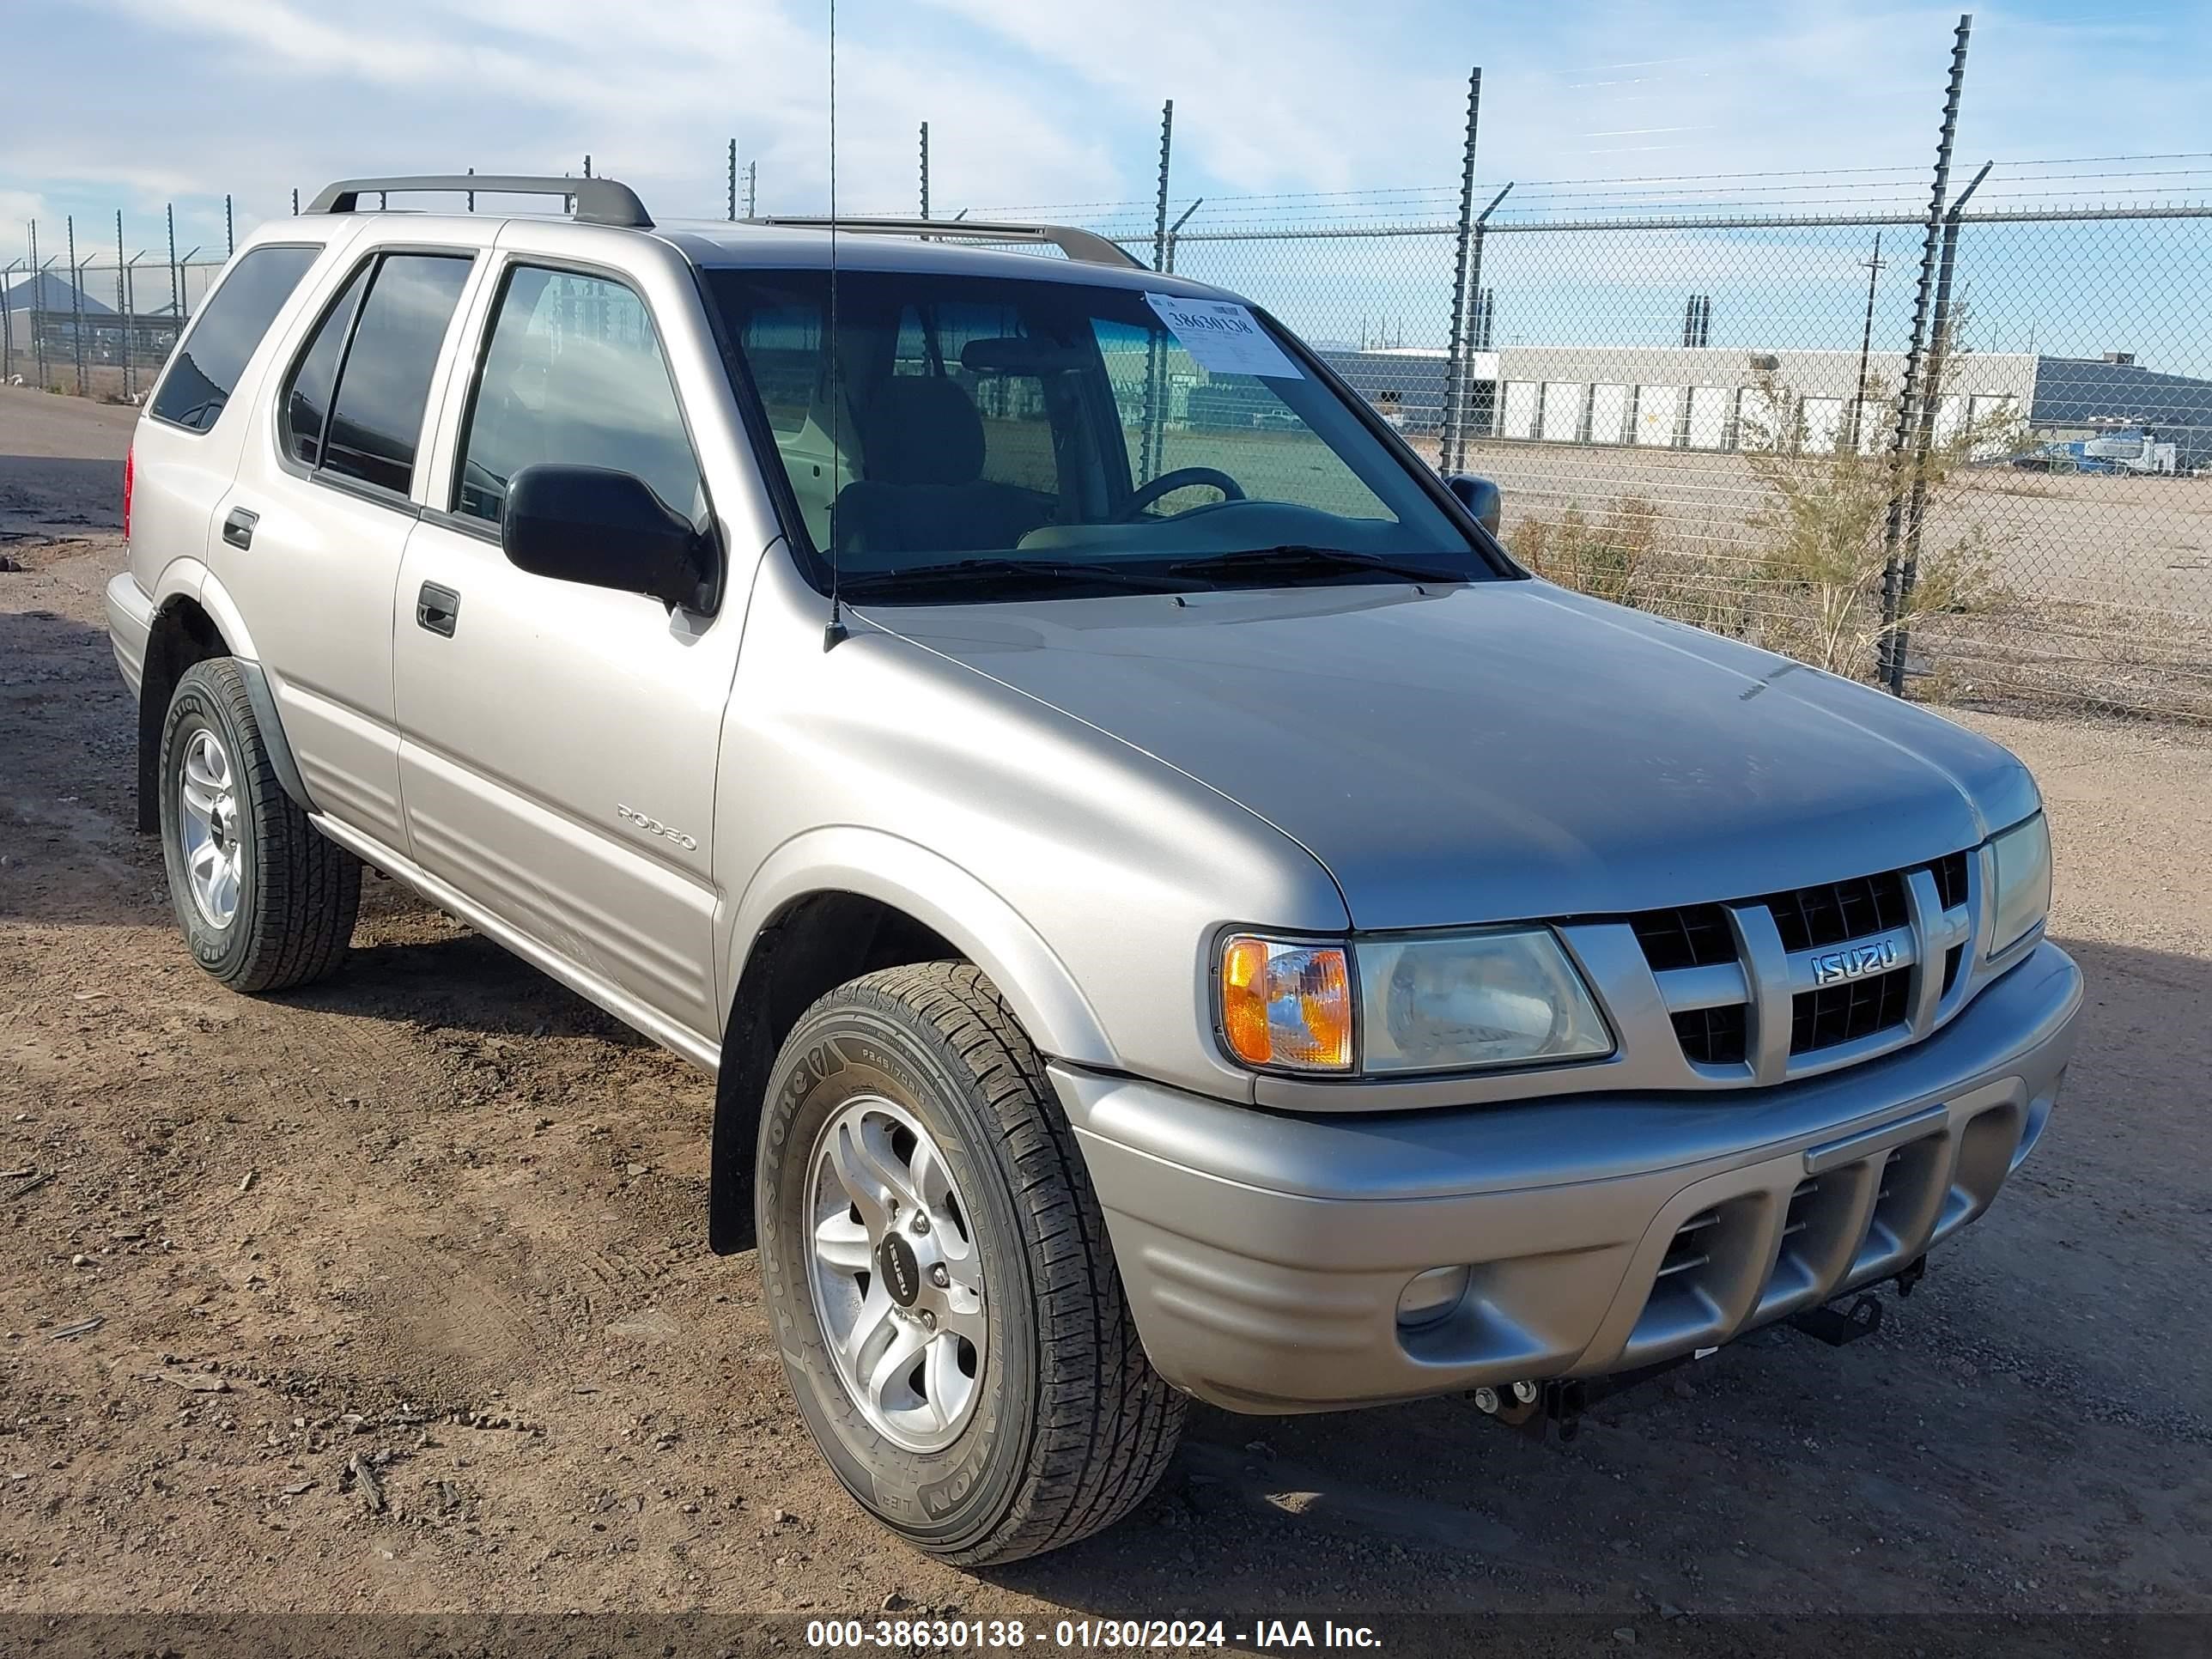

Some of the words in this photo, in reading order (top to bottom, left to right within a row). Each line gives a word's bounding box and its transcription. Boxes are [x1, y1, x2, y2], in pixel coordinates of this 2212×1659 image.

[617, 803, 697, 851] RODEO
[1812, 939, 1898, 985] ISUZU
[889, 1243, 908, 1297] ISUZU
